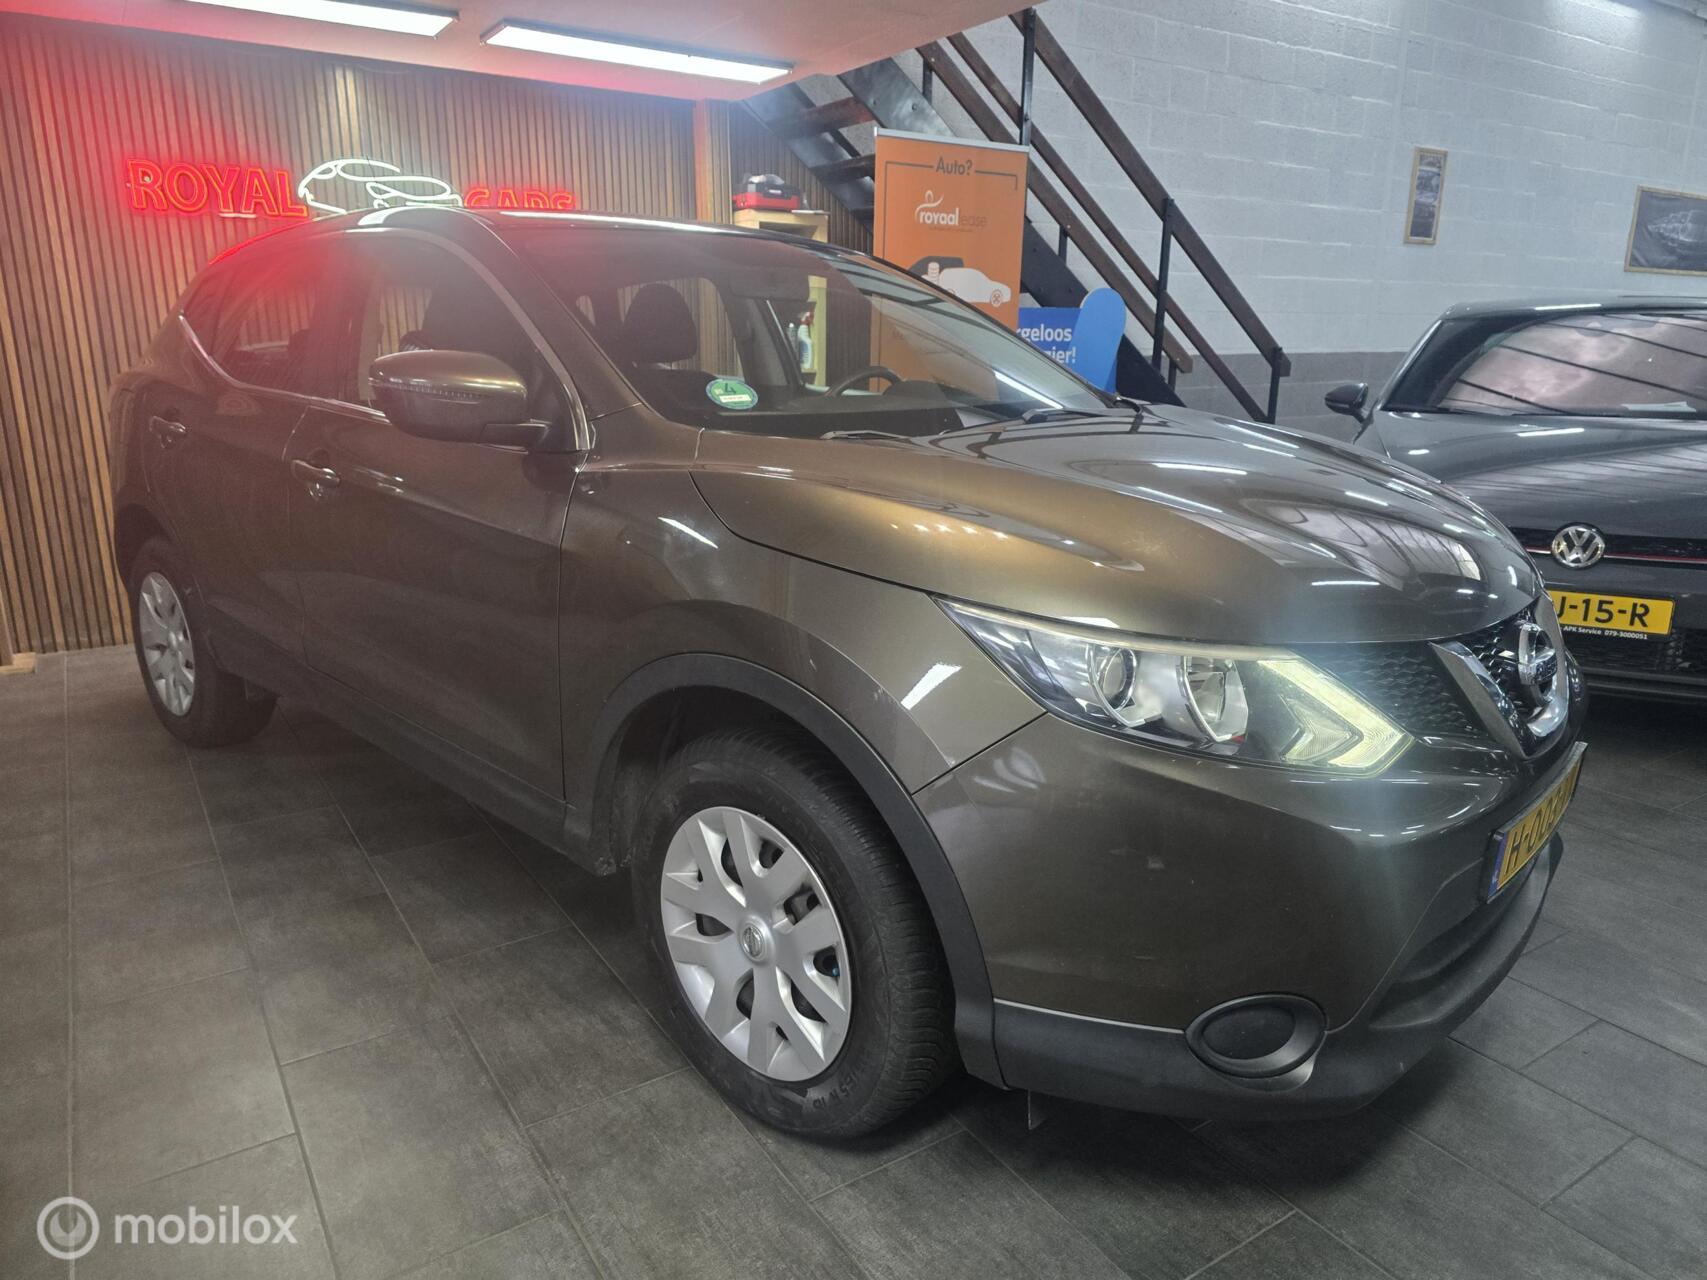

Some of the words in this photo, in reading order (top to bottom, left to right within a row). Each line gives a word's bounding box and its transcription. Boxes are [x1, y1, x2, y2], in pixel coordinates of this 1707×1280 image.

[935, 157, 973, 176] Auto?
[128, 159, 308, 217] ROYAL
[1017, 323, 1072, 342] geloos
[1578, 627, 1602, 636] Service
